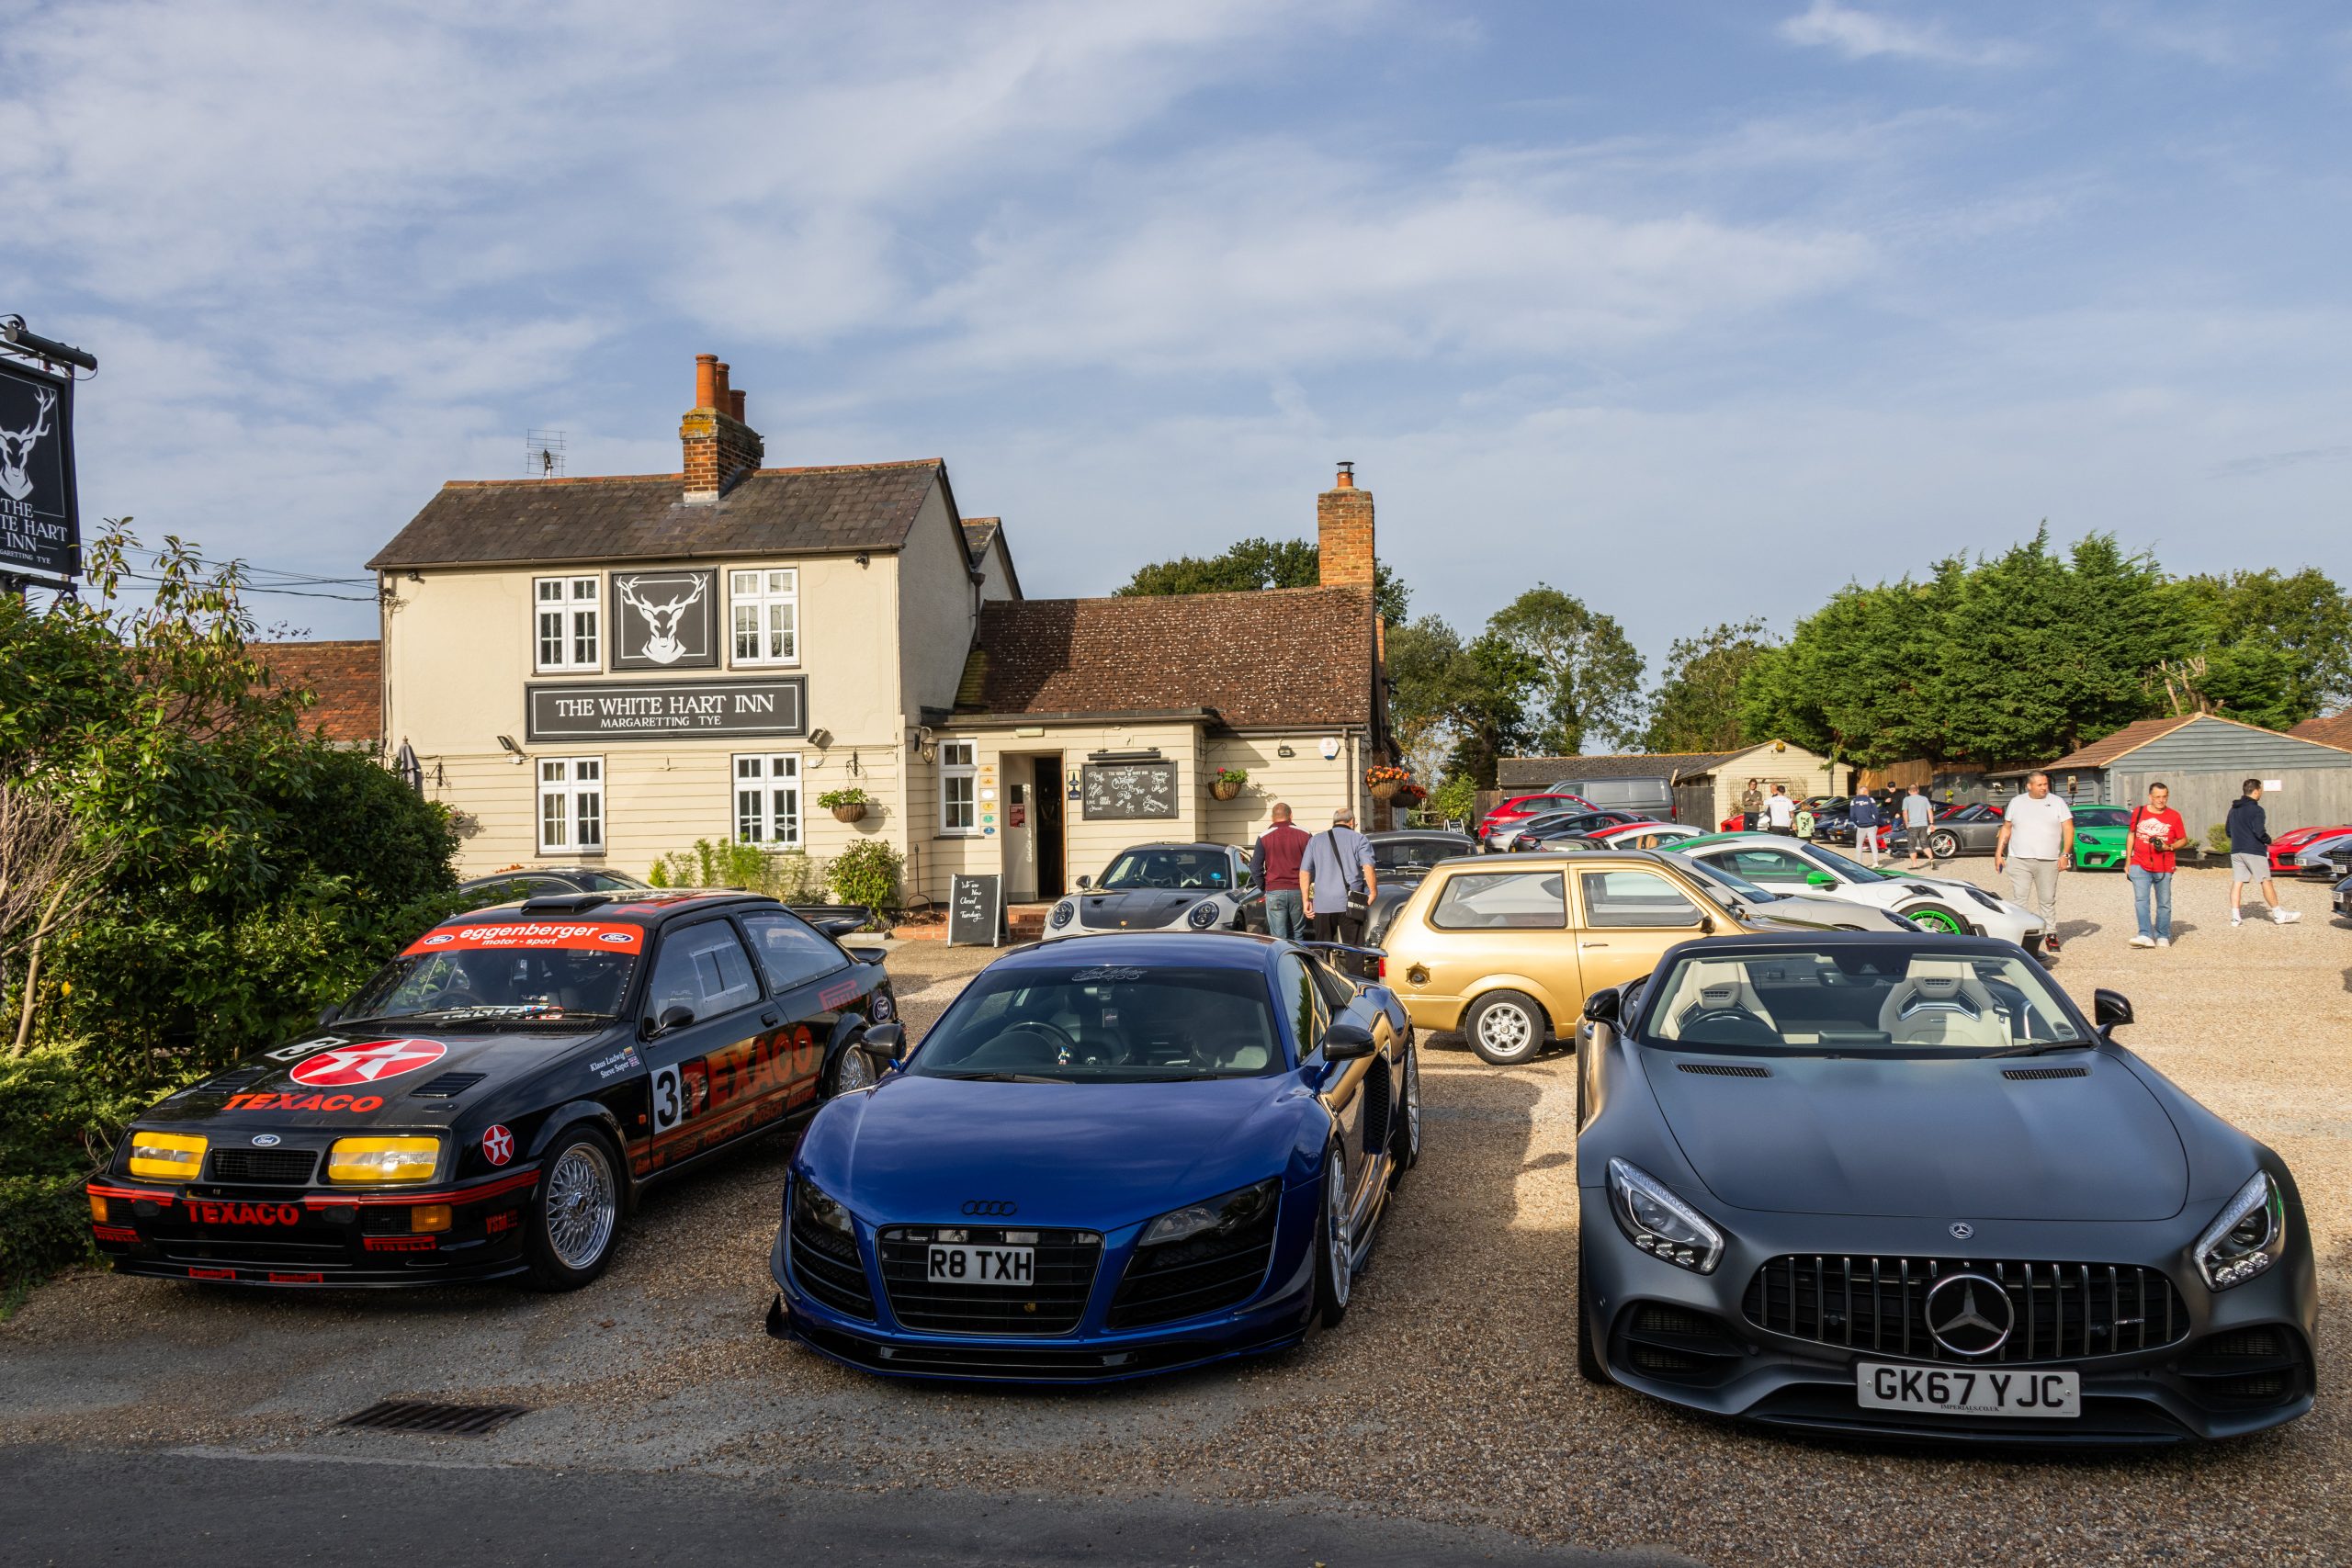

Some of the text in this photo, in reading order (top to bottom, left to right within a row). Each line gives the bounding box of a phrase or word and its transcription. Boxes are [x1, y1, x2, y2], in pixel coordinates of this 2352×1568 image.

[0, 498, 33, 519] THE
[24, 519, 68, 542] HART
[6, 531, 37, 552] INN
[37, 556, 51, 565] TYE
[555, 694, 775, 716] THE WHITE HART INN
[600, 716, 721, 728] MARGARETTING TYE
[459, 923, 599, 940] eggenberger
[526, 937, 558, 946] sport
[590, 1052, 626, 1072] Klaus Ludwig
[600, 1061, 629, 1078] Steve Soper
[681, 1025, 813, 1119] TEXACO
[220, 1093, 384, 1112] TEXACO
[656, 1070, 679, 1128] 3
[182, 1201, 299, 1225] TEXACO
[363, 1235, 436, 1251] PIRELLI
[930, 1249, 1033, 1280] R8 TXH
[1874, 1368, 2064, 1408] GK67 YJC
